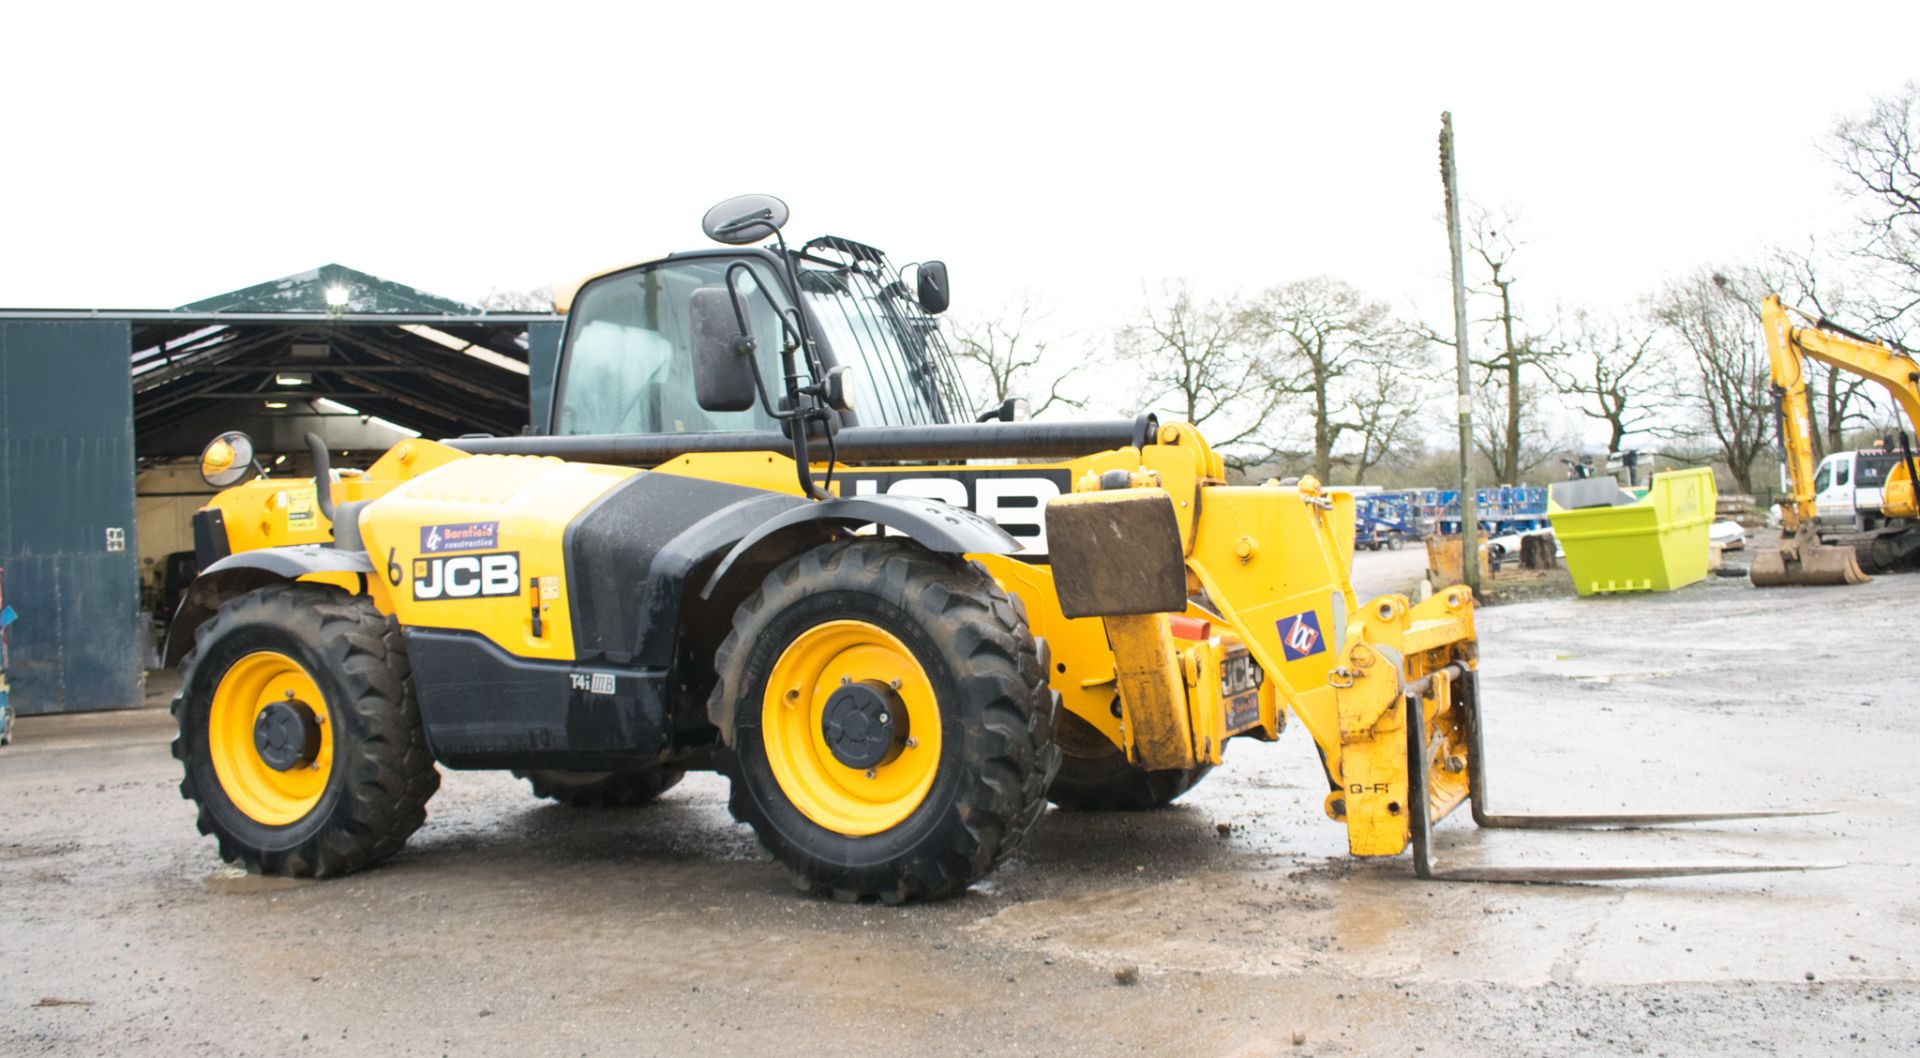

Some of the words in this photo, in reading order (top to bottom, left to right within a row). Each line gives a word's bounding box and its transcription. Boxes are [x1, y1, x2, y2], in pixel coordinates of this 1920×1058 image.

[444, 524, 494, 539] Barnfield
[444, 539, 493, 549] construction
[388, 547, 403, 587] 6
[415, 554, 519, 598] JCB
[569, 673, 590, 690] T4i
